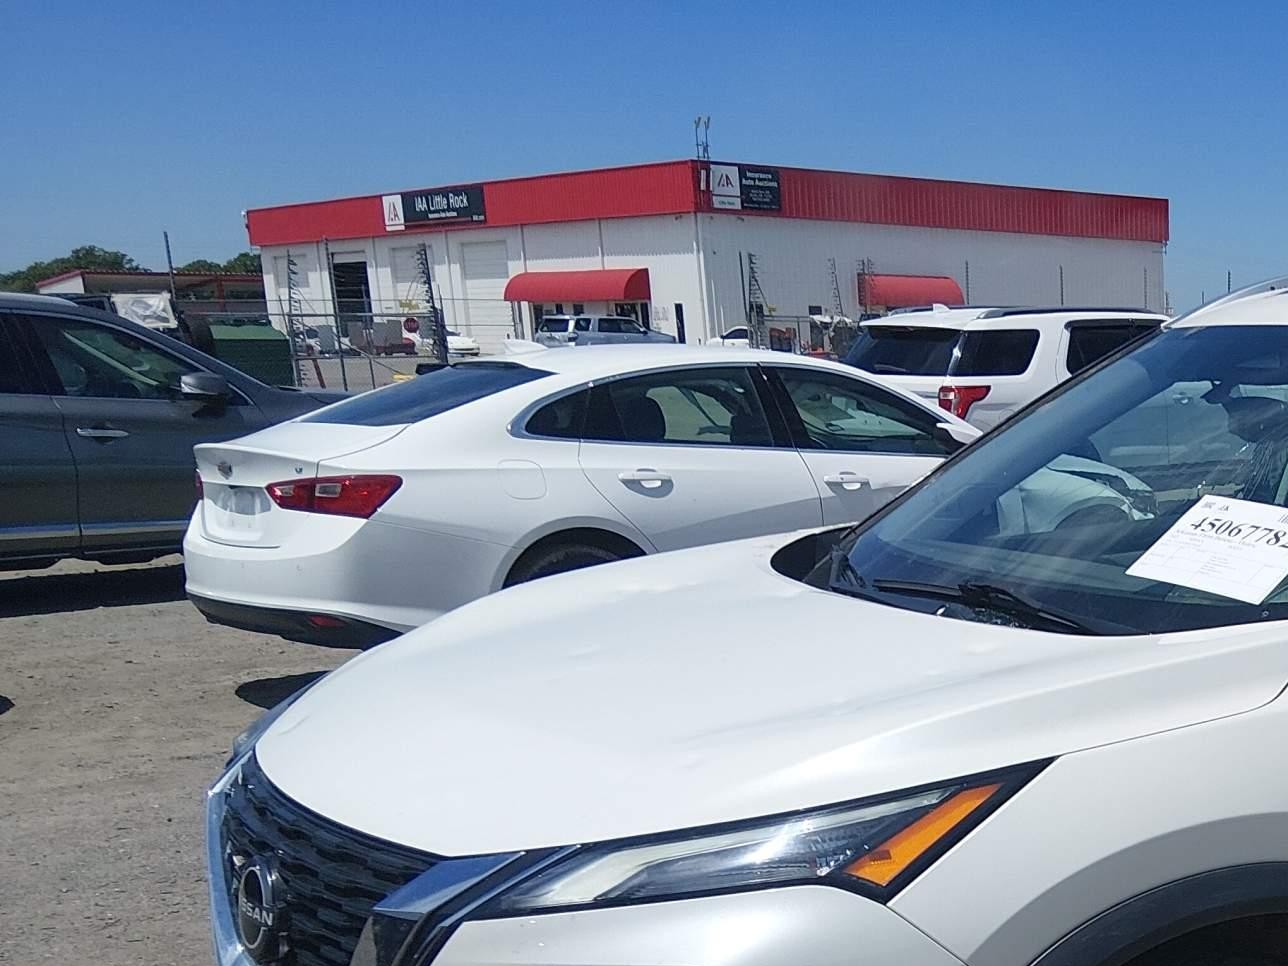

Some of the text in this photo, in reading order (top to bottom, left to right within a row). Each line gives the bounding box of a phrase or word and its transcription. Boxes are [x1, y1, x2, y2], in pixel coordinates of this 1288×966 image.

[414, 192, 469, 212] IAA Little Rock
